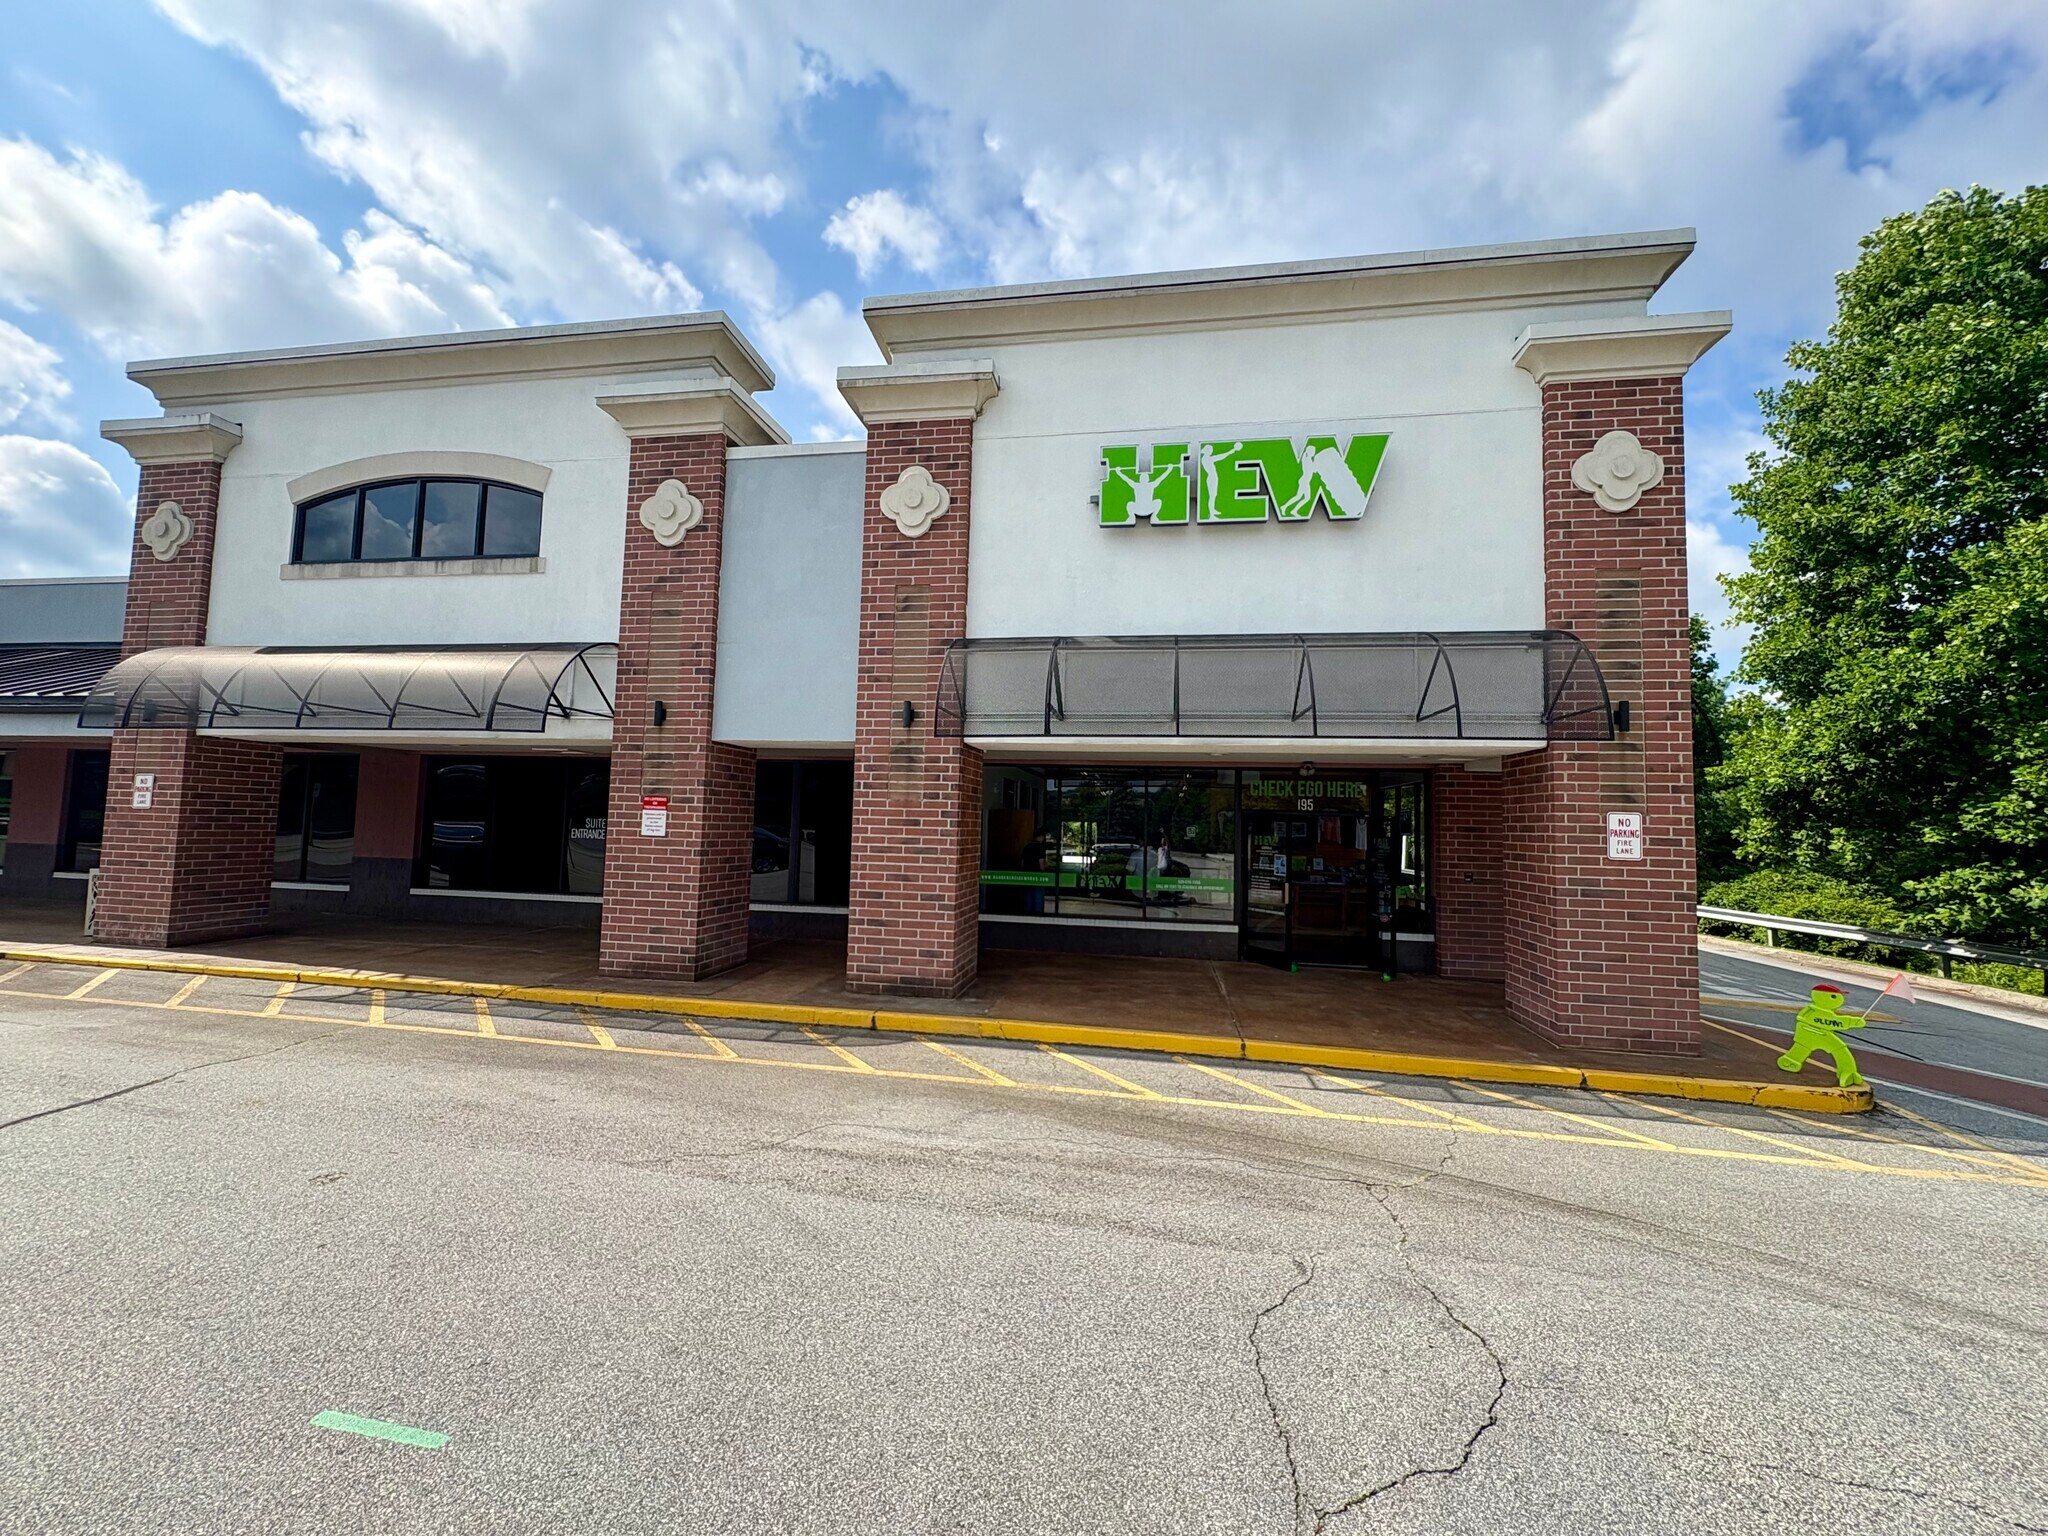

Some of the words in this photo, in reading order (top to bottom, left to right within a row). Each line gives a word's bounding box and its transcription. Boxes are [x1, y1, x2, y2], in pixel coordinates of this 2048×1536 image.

[1100, 432, 1393, 525] HEW
[1249, 779, 1294, 798] CHECK
[1297, 780, 1323, 798] EGO
[1327, 781, 1363, 799] HERE
[1297, 799, 1314, 811] 195
[585, 817, 607, 829] SUITE
[1618, 818, 1631, 828] NO
[571, 828, 606, 840] ENTRANCE
[1610, 829, 1640, 839] PARKING
